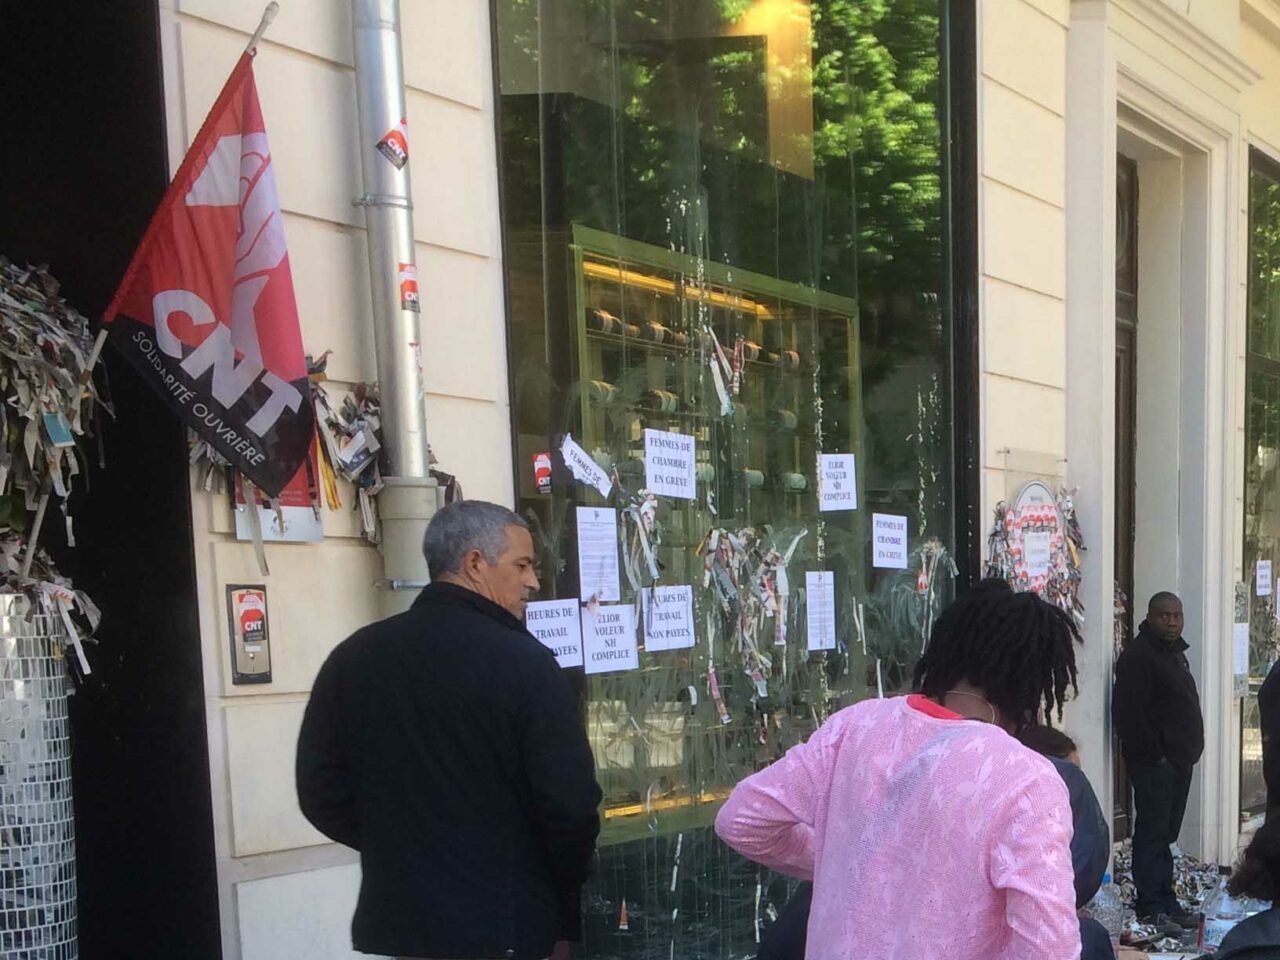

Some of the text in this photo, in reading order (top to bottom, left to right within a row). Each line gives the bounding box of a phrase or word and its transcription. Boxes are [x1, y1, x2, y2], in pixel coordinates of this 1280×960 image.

[152, 289, 304, 438] CNT
[131, 330, 266, 466] SOLIDARITÉ OUVRIÈRE
[650, 437, 691, 451] FEMMES DE
[569, 449, 602, 485] FEMMES DE
[652, 456, 687, 469] CHAMBRE
[654, 474, 664, 484] EN
[527, 607, 574, 620] HEURES DE
[244, 620, 263, 632] CNT
[595, 625, 625, 636] VOLEUR
[534, 627, 568, 639] TRAVAIL
[604, 639, 616, 648] NH
[591, 649, 631, 662] COMPLICE
